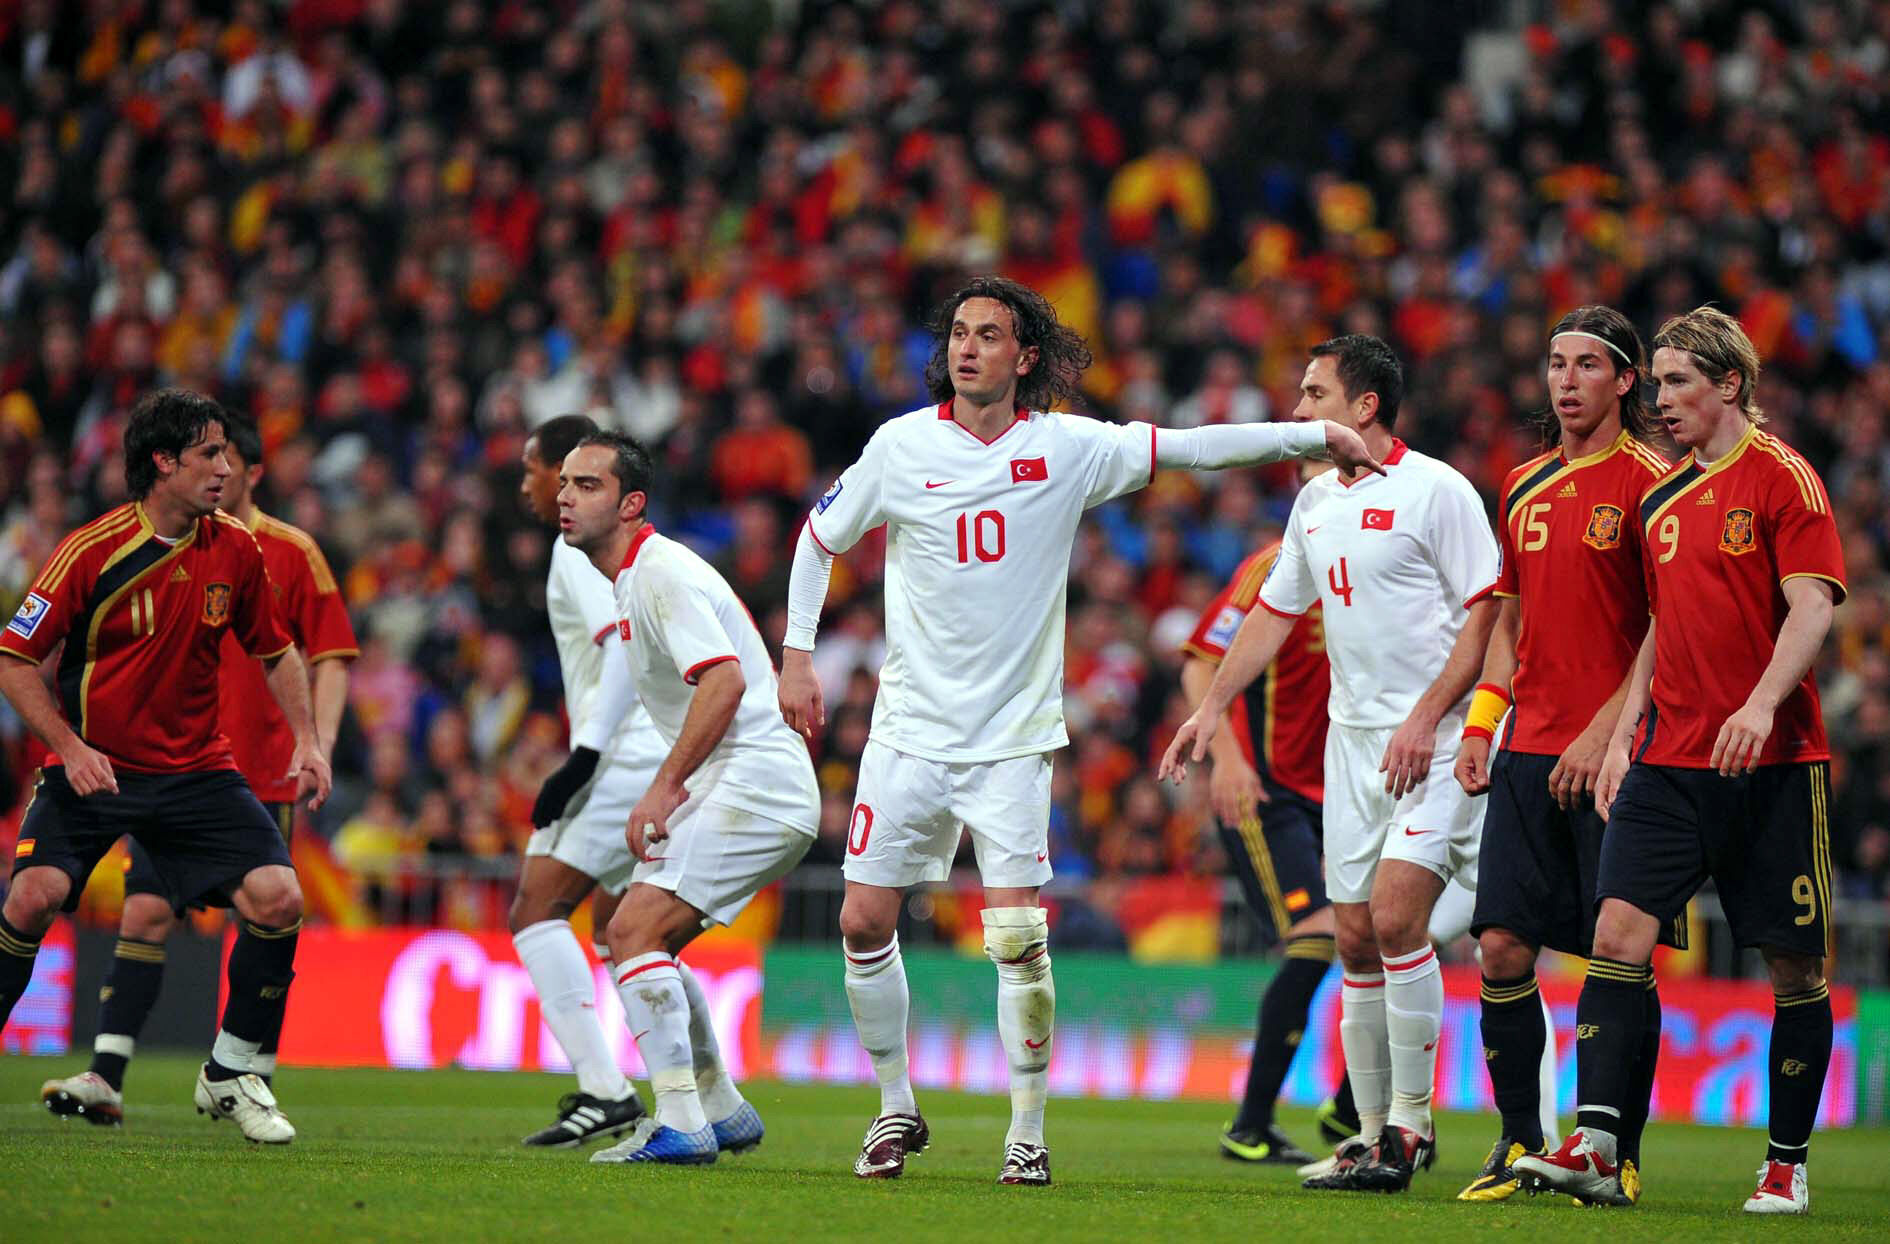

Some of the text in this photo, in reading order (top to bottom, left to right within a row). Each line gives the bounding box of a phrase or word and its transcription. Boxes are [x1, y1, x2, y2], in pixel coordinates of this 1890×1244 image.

[956, 509, 1006, 563] 10
[1517, 502, 1552, 553] 15
[1657, 514, 1680, 564] 9
[1327, 556, 1354, 607] 4
[130, 587, 155, 637] 11
[1791, 874, 1817, 926] 9
